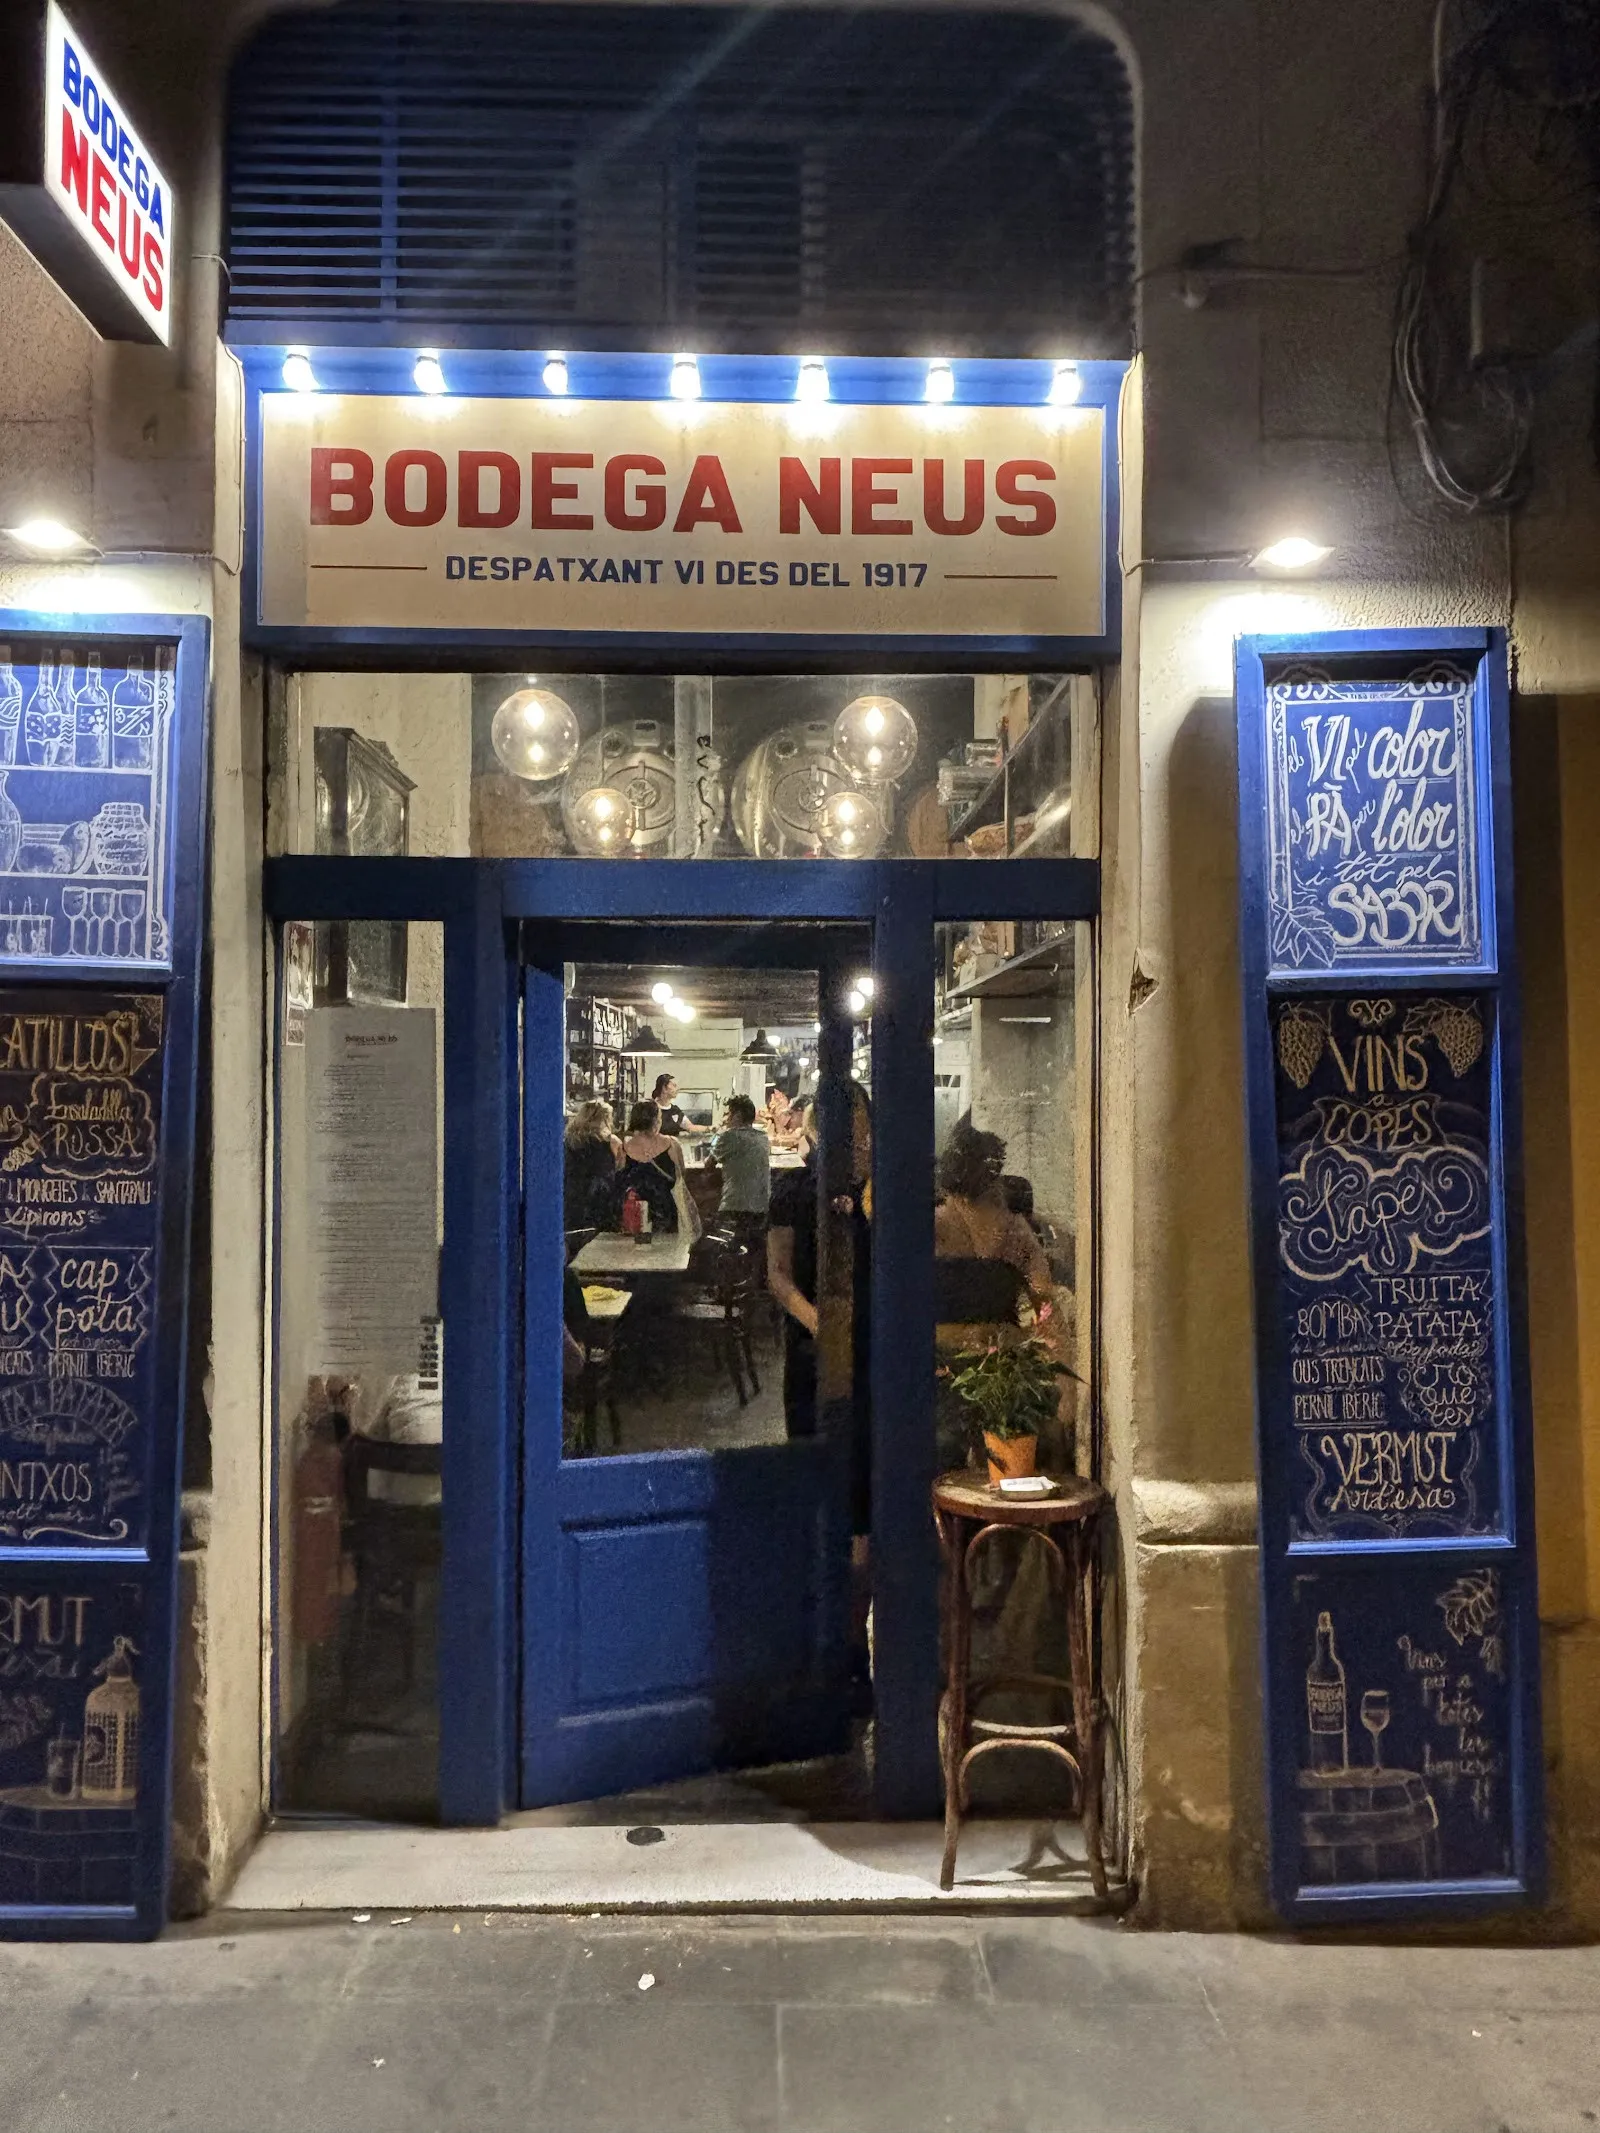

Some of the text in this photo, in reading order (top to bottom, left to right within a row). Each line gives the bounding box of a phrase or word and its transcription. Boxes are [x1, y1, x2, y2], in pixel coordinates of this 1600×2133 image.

[63, 37, 165, 240] BODEGA
[61, 103, 164, 312] NEUS
[310, 447, 1058, 535] BODEGA NEUS
[445, 555, 928, 588] DESPATXANT VI DES DEL 1917
[1301, 714, 1351, 786] VI
[1345, 728, 1367, 793] pel
[1367, 700, 1457, 780] color
[1333, 851, 1397, 883] tot
[0, 1014, 132, 1073] ATILLOS
[1328, 1034, 1428, 1092] VINS
[54, 1123, 143, 1162] RUSSA
[1324, 1100, 1432, 1150] COPES
[61, 1258, 119, 1305] cap
[1371, 1275, 1481, 1304] TRUITA
[56, 1292, 137, 1350] pota
[1297, 1300, 1368, 1342] BOMBA
[1374, 1309, 1483, 1338] PATATA
[1320, 1430, 1458, 1485] VERMUT
